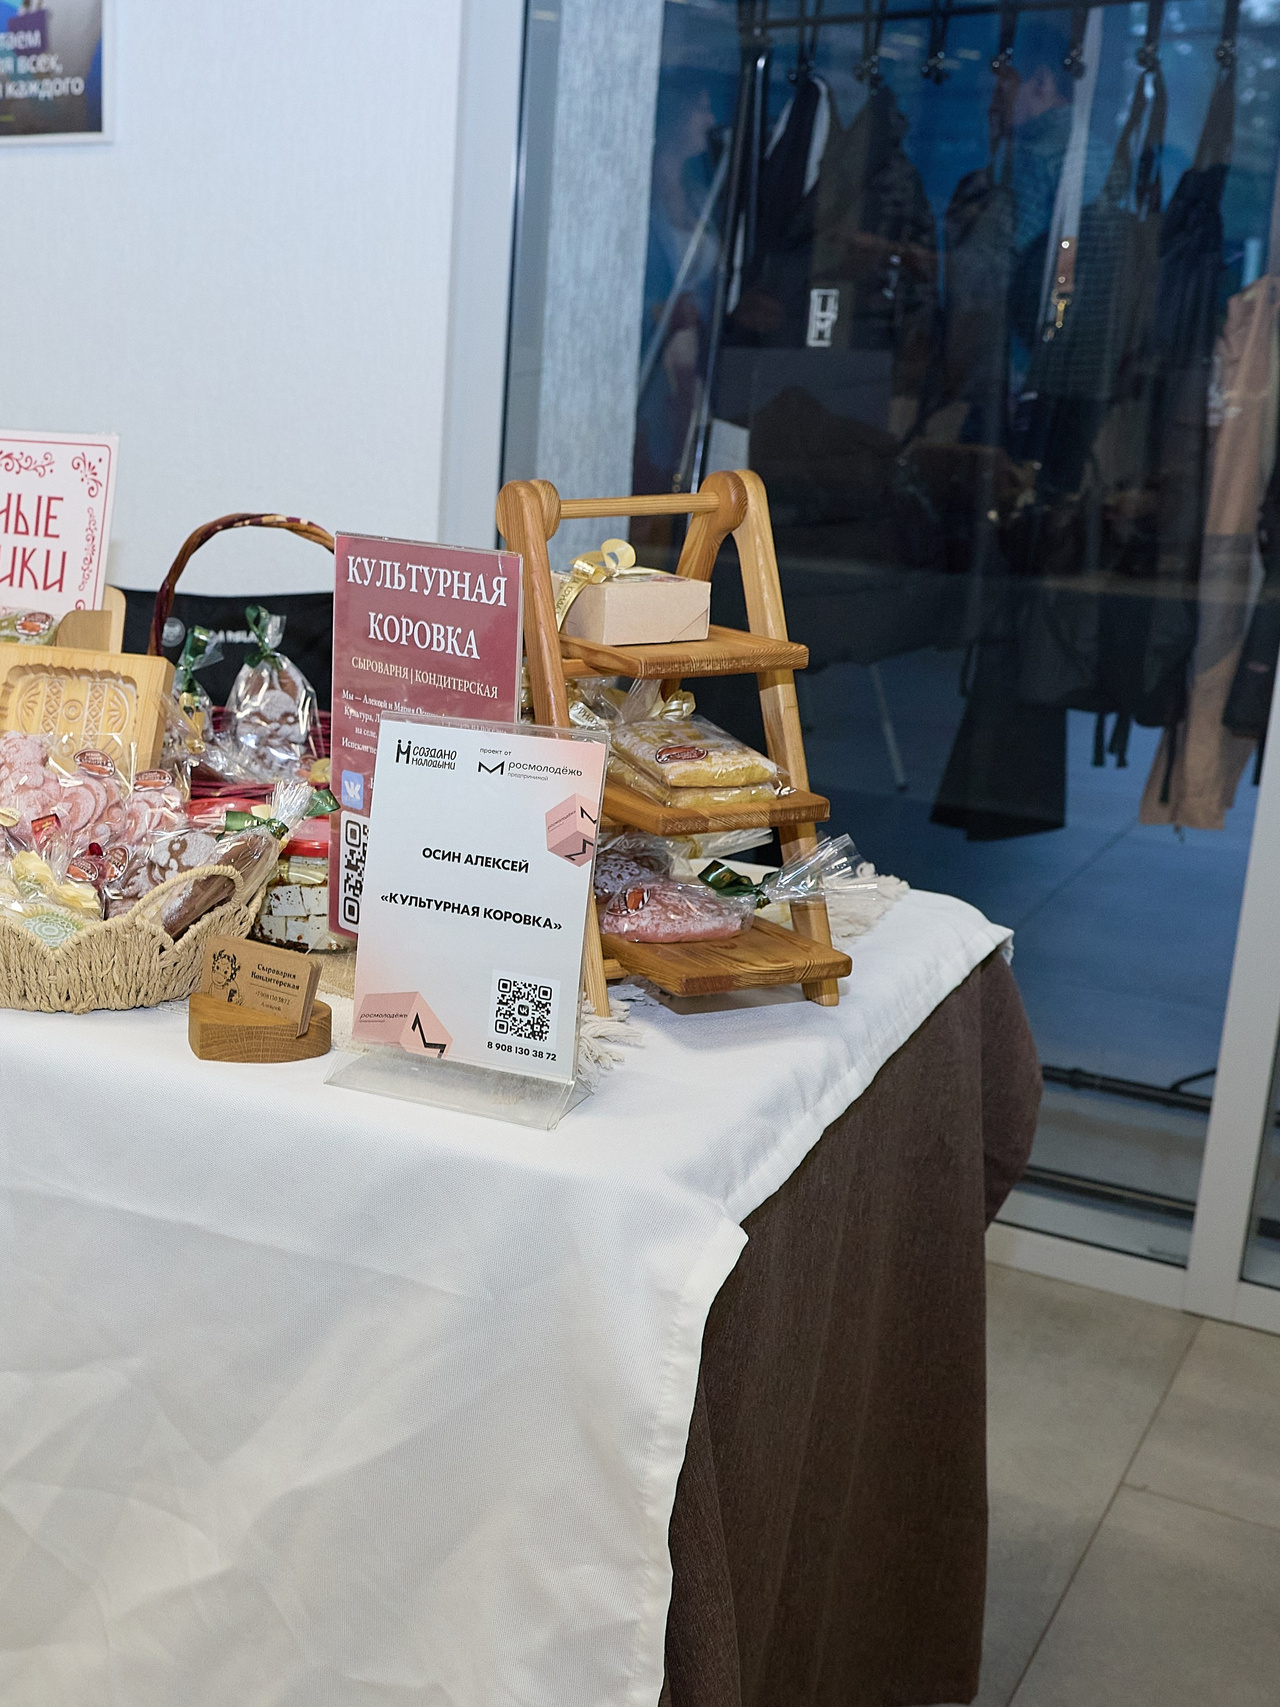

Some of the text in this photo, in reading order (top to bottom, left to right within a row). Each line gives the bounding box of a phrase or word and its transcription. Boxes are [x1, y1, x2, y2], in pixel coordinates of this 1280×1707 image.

[17, 53, 63, 75] всех,
[5, 76, 84, 101] каждого
[347, 555, 507, 607] КУЛЬТУРНАЯ
[368, 611, 480, 660] КОРОВКА
[342, 689, 354, 701] Мы
[355, 726, 363, 735] на
[412, 746, 457, 760] СОЗДАНО
[480, 748, 503, 756] проект
[508, 761, 583, 777] росмолодёжь
[422, 847, 530, 874] ОСИН АЛЕКСЕЙ
[380, 892, 562, 930] «КУЛЬТУРНАЯ КОРОВКА»
[251, 971, 300, 990] Кондитерская
[257, 963, 296, 980] Сыроварня
[487, 1041, 557, 1061] 8 908 130 38 72
